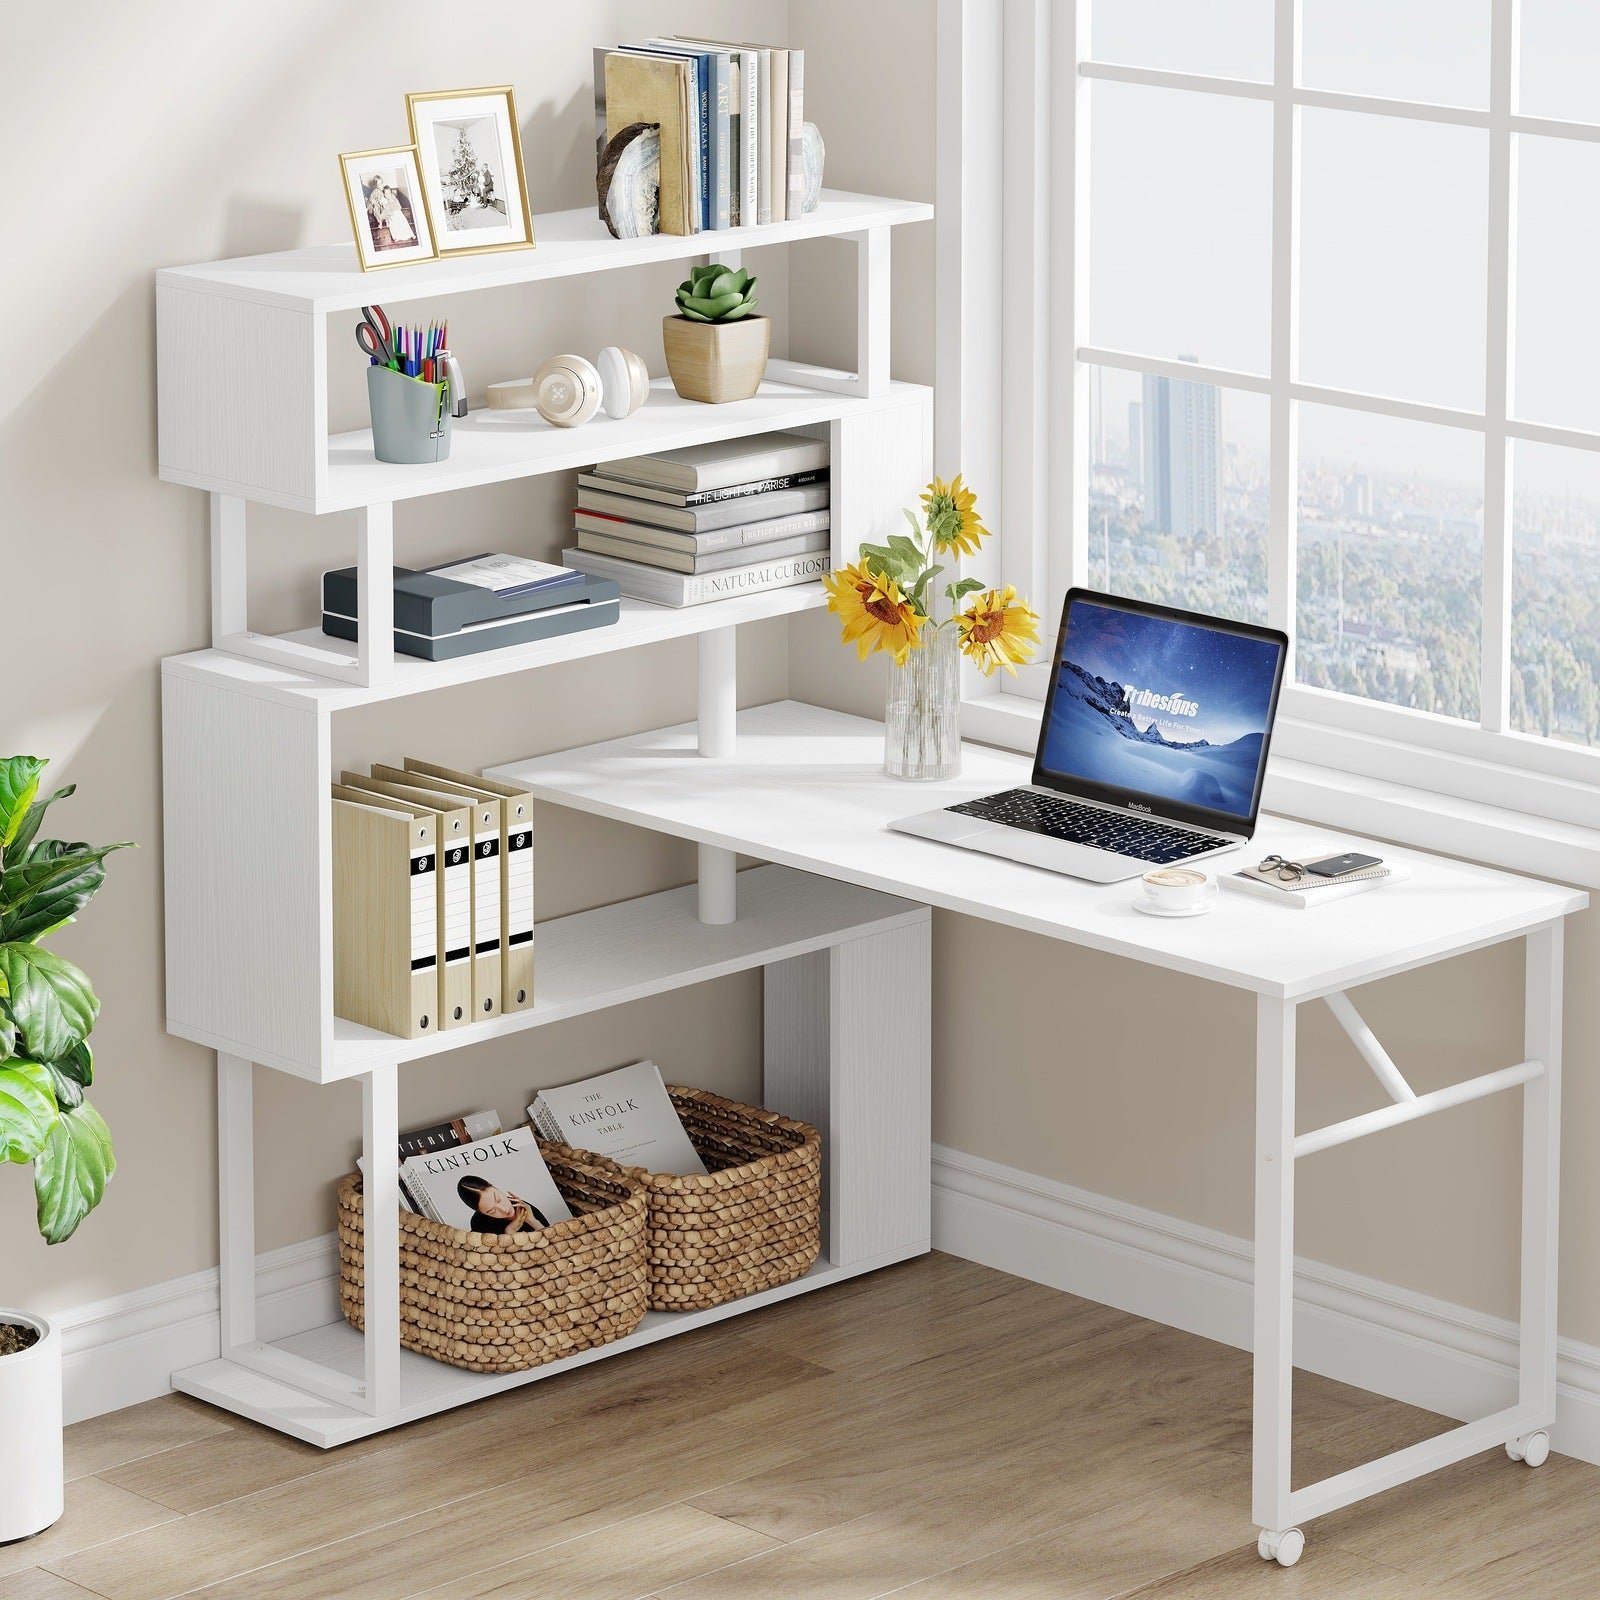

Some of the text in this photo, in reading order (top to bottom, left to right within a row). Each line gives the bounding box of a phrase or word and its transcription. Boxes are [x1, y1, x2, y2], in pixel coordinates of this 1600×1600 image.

[718, 82, 729, 116] ART
[694, 491, 712, 505] THE
[714, 486, 741, 502] LIGHT
[743, 485, 757, 496] OF
[711, 568, 772, 593] NATURAL
[774, 556, 831, 580] CURIOSIT
[1121, 684, 1199, 717] Tribesigns
[1127, 801, 1152, 814] MacBook
[582, 1092, 603, 1103] THE
[569, 1098, 640, 1127] KINFOLK
[596, 1123, 625, 1135] TABLE
[398, 1132, 446, 1153] TTERY
[424, 1138, 520, 1175] KINFOLK
